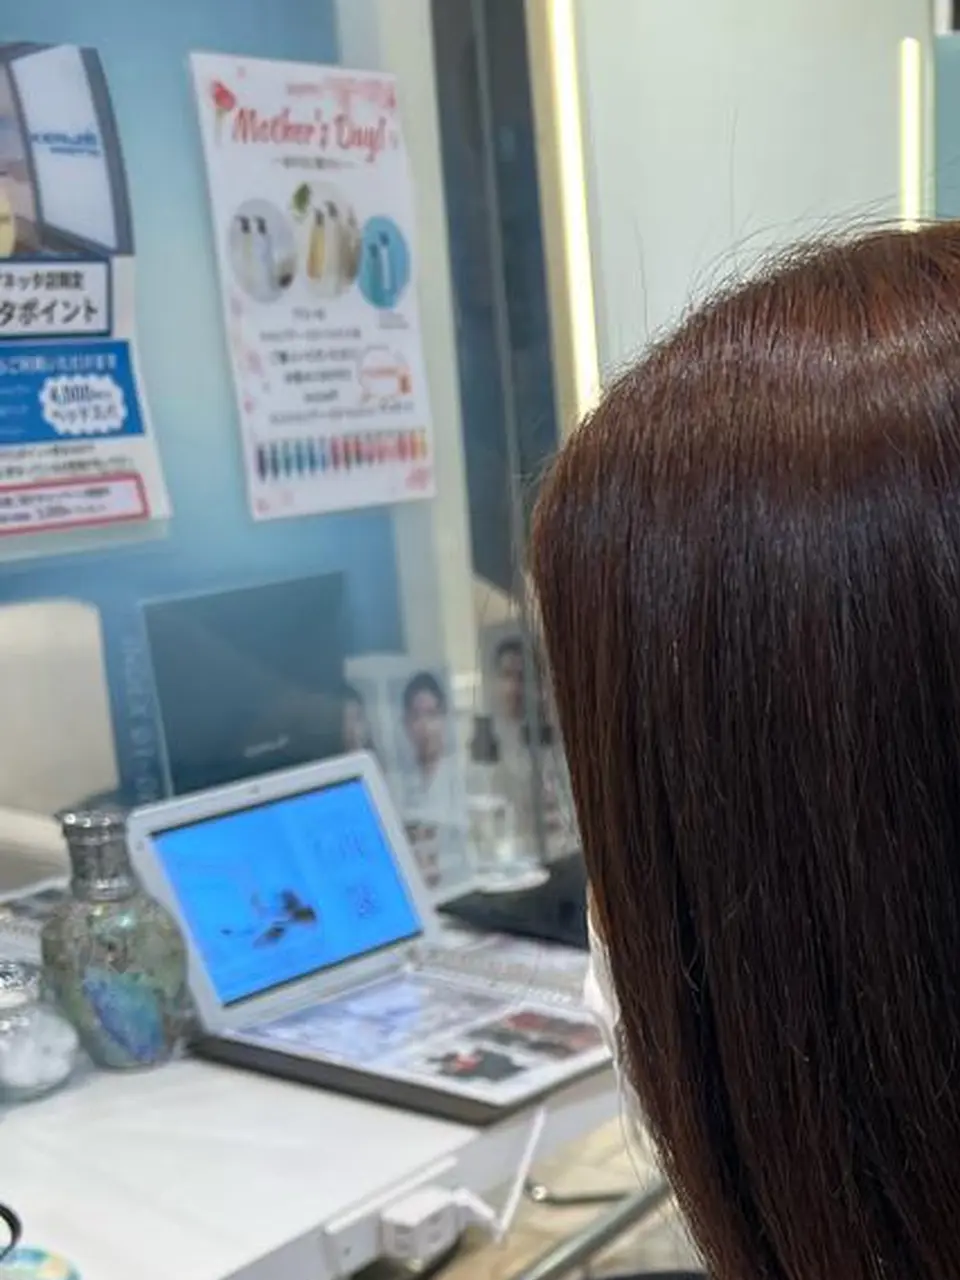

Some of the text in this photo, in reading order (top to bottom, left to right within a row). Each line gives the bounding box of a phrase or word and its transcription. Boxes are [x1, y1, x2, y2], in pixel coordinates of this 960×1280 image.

[232, 107, 329, 149] Mother's
[0, 271, 84, 291] ネッタ店限定
